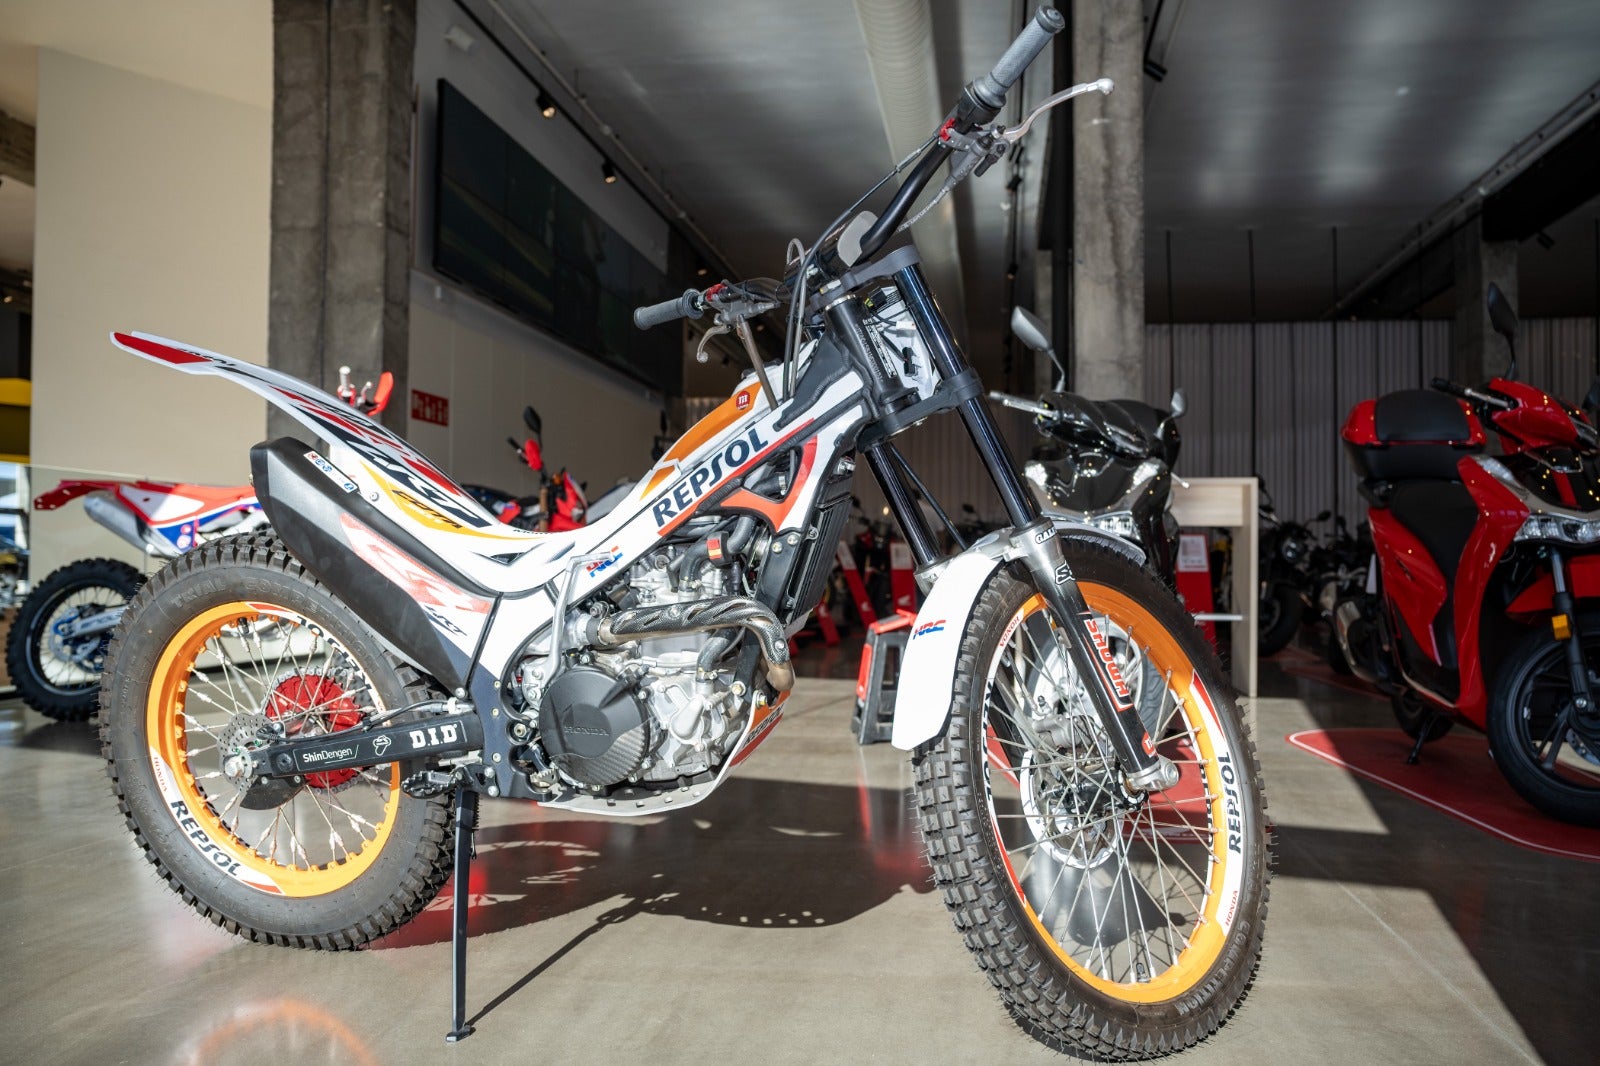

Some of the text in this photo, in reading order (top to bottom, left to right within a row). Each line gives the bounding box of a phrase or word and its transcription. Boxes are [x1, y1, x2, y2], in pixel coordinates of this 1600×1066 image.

[652, 428, 769, 527] REPSOL
[913, 620, 946, 640] HRC
[1000, 616, 1020, 647] HONDA
[1084, 619, 1130, 698] SHOWA
[564, 726, 610, 737] HONDA
[153, 756, 168, 793] HONDA
[302, 748, 353, 764] ShinDengen
[1218, 751, 1243, 854] REPSOL
[170, 800, 242, 877] REPSOL
[1224, 889, 1239, 928] HONDA
